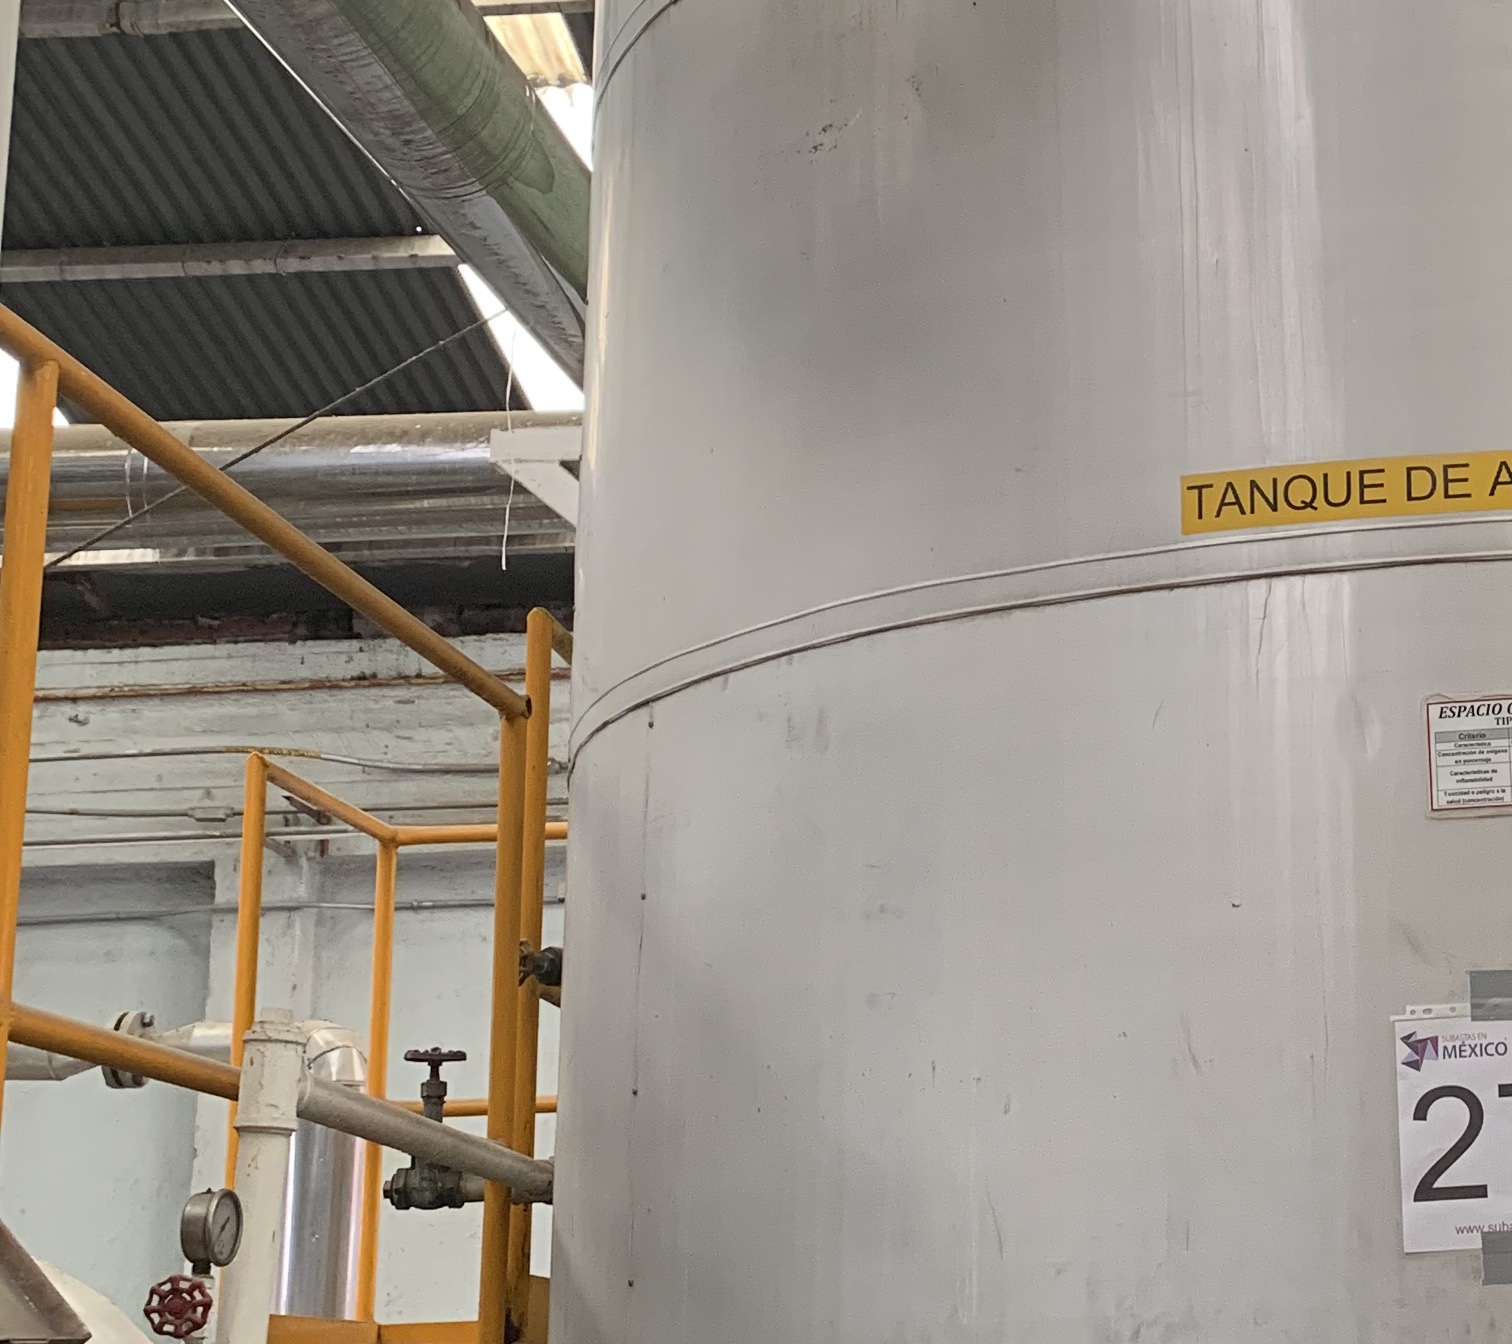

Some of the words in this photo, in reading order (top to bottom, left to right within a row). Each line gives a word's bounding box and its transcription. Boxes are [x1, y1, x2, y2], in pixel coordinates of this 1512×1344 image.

[1187, 468, 1387, 521] TANQUE
[1405, 462, 1472, 502] DE
[1439, 703, 1502, 719] ESPACIO
[1458, 731, 1486, 740] Criterio
[1441, 1033, 1476, 1043] SUBASTAS
[1477, 1032, 1487, 1040] EN
[1442, 1040, 1508, 1060] MÉXICO
